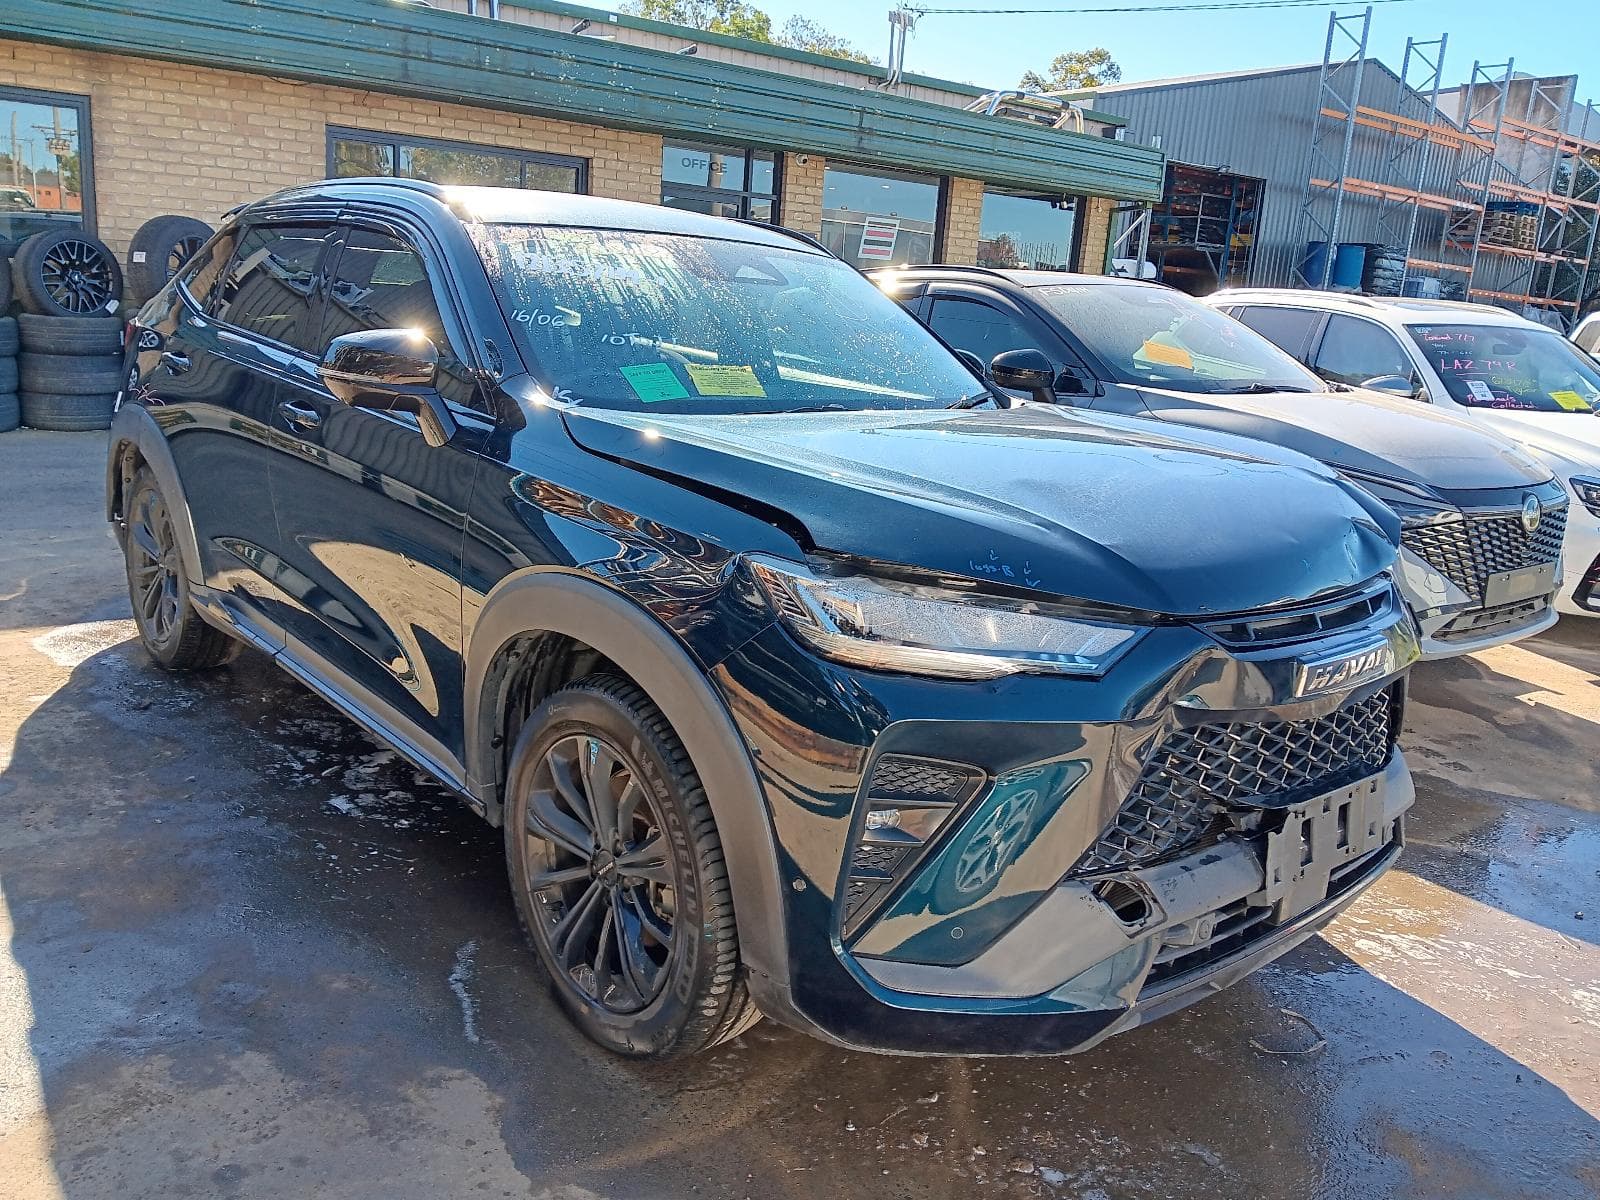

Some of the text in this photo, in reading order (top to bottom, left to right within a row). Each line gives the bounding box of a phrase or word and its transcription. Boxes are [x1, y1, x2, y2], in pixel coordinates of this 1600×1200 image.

[681, 157, 728, 174] OFFICE
[511, 308, 565, 328] 16/06
[1441, 359, 1475, 373] LAZ
[1307, 649, 1384, 691] HAVAL
[653, 778, 697, 914] MICHELIN
